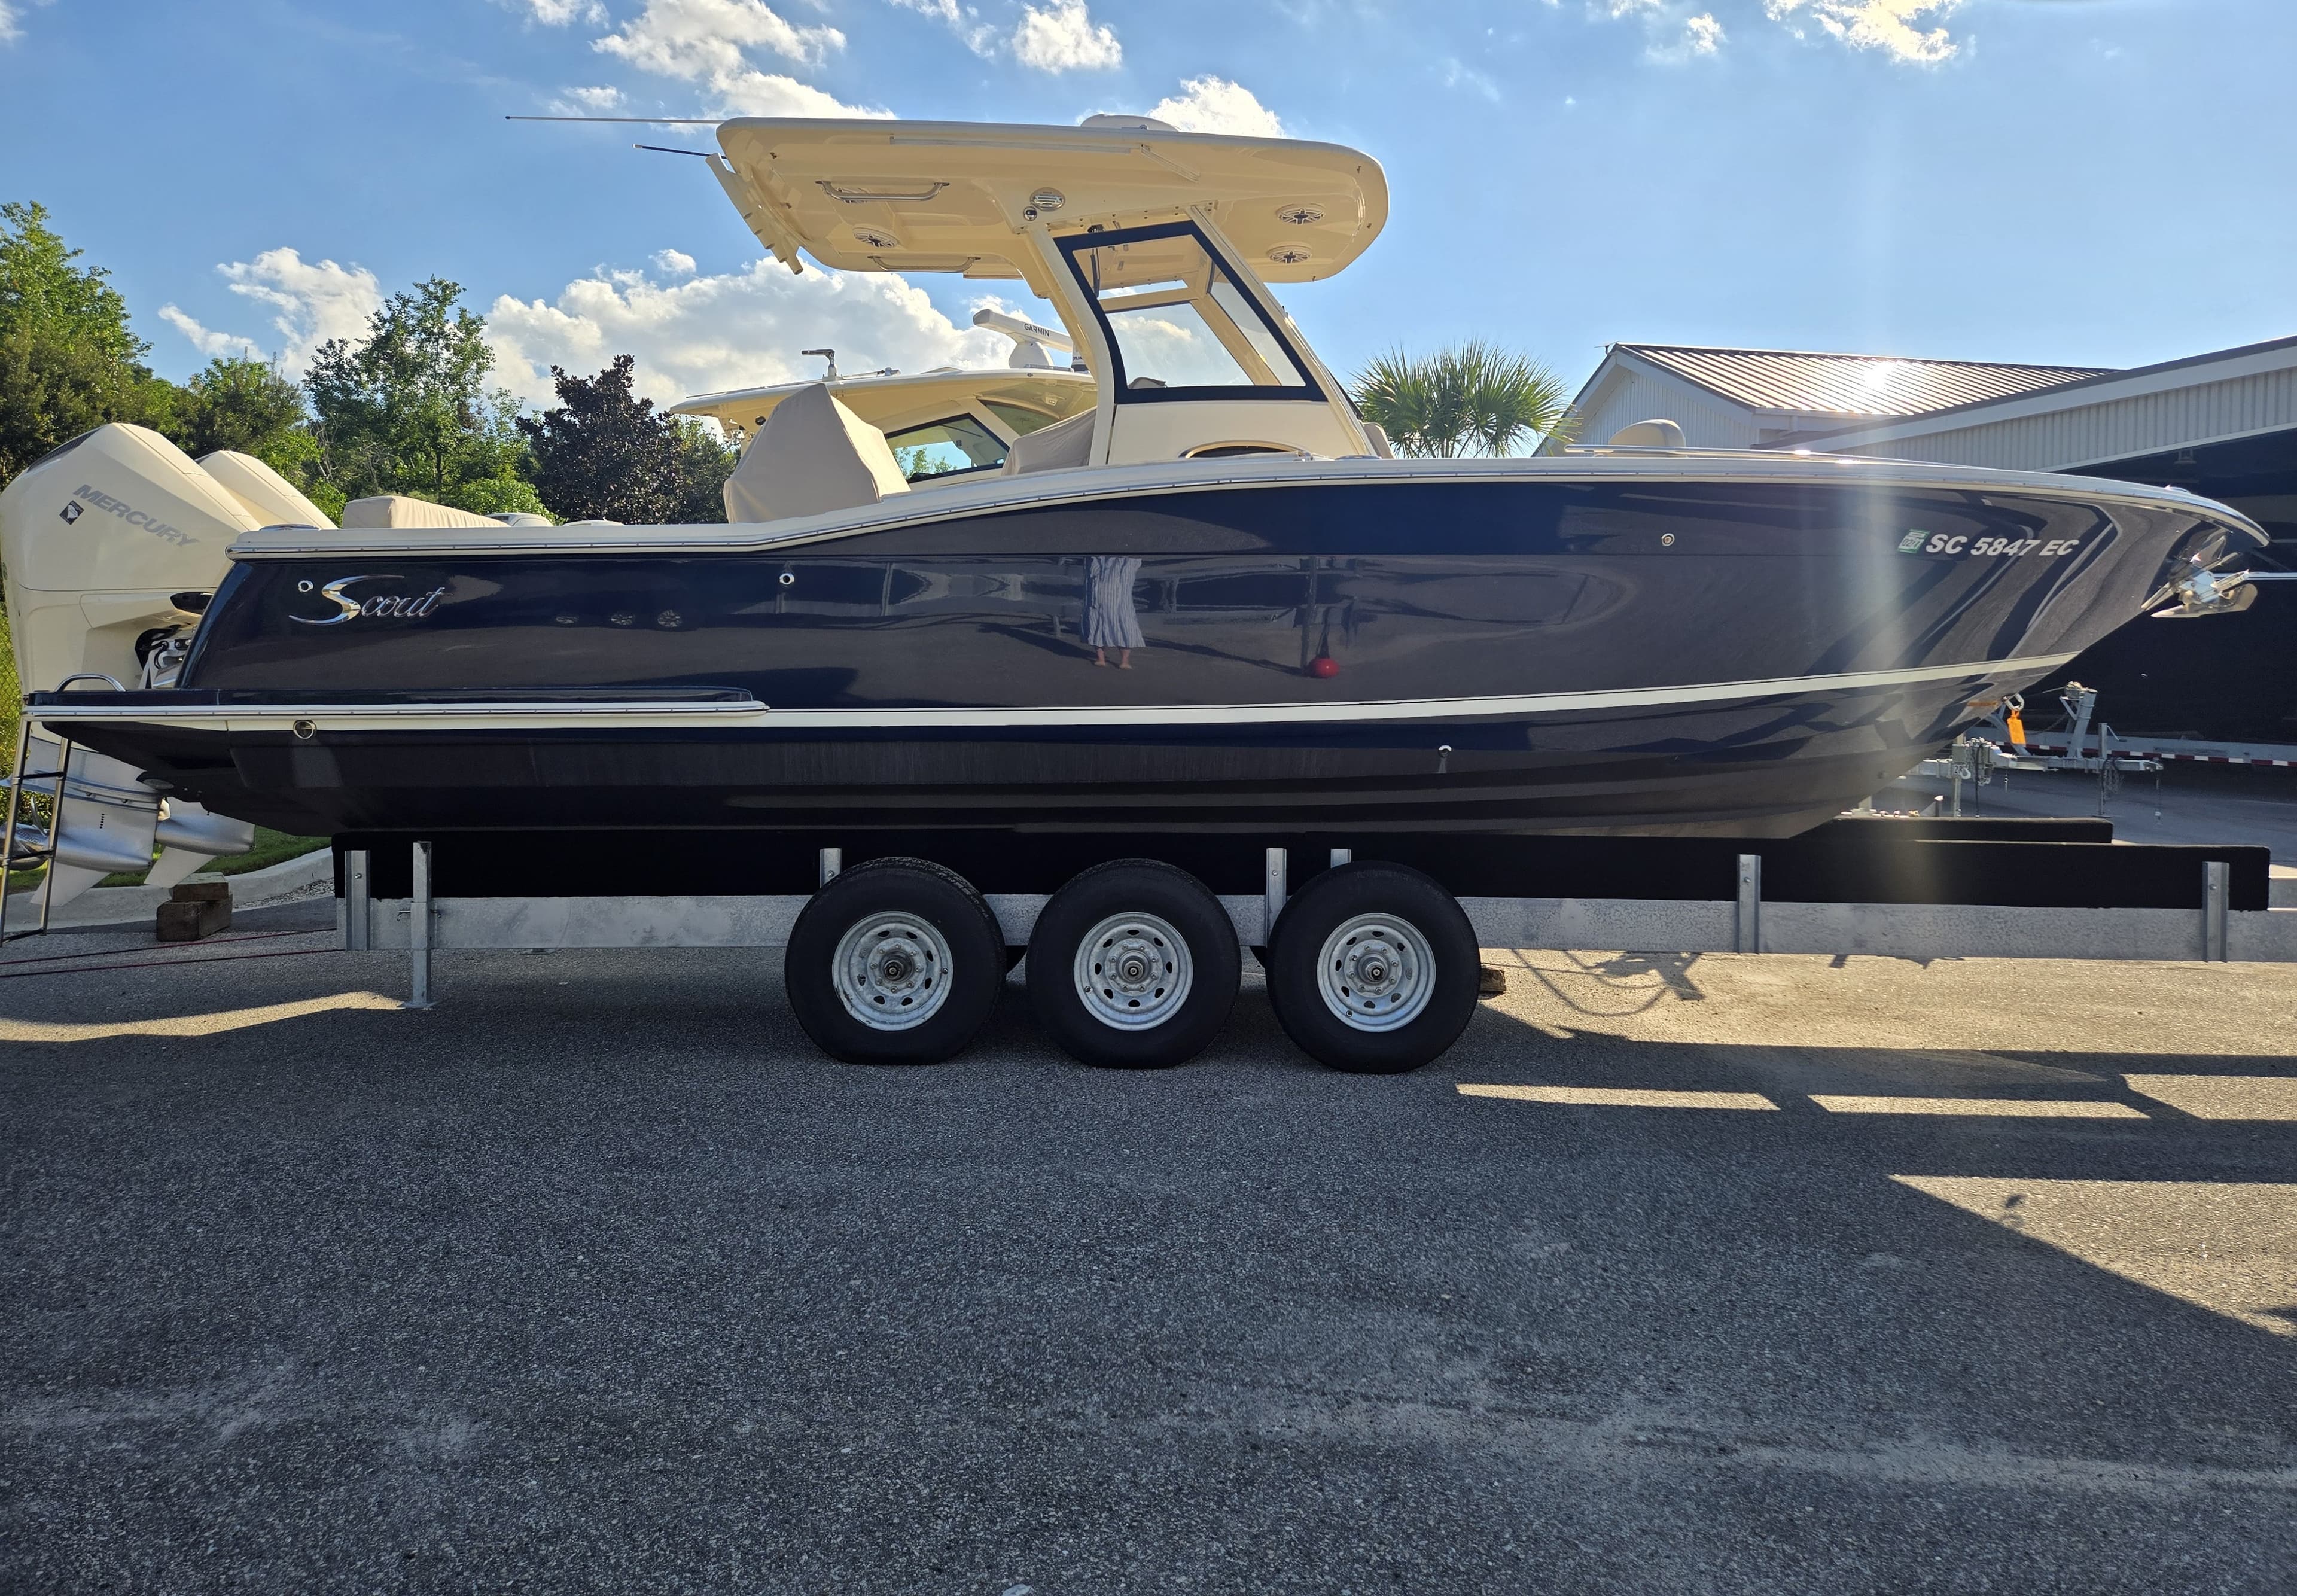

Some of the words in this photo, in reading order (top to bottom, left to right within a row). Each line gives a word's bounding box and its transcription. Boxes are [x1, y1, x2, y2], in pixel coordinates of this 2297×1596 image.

[1024, 323, 1050, 337] GARMIN
[72, 484, 200, 547] MERCURY
[1926, 534, 1967, 554] SC
[1970, 537, 2041, 556] 5847
[2039, 540, 2079, 556] EC
[288, 574, 452, 625] Scout
